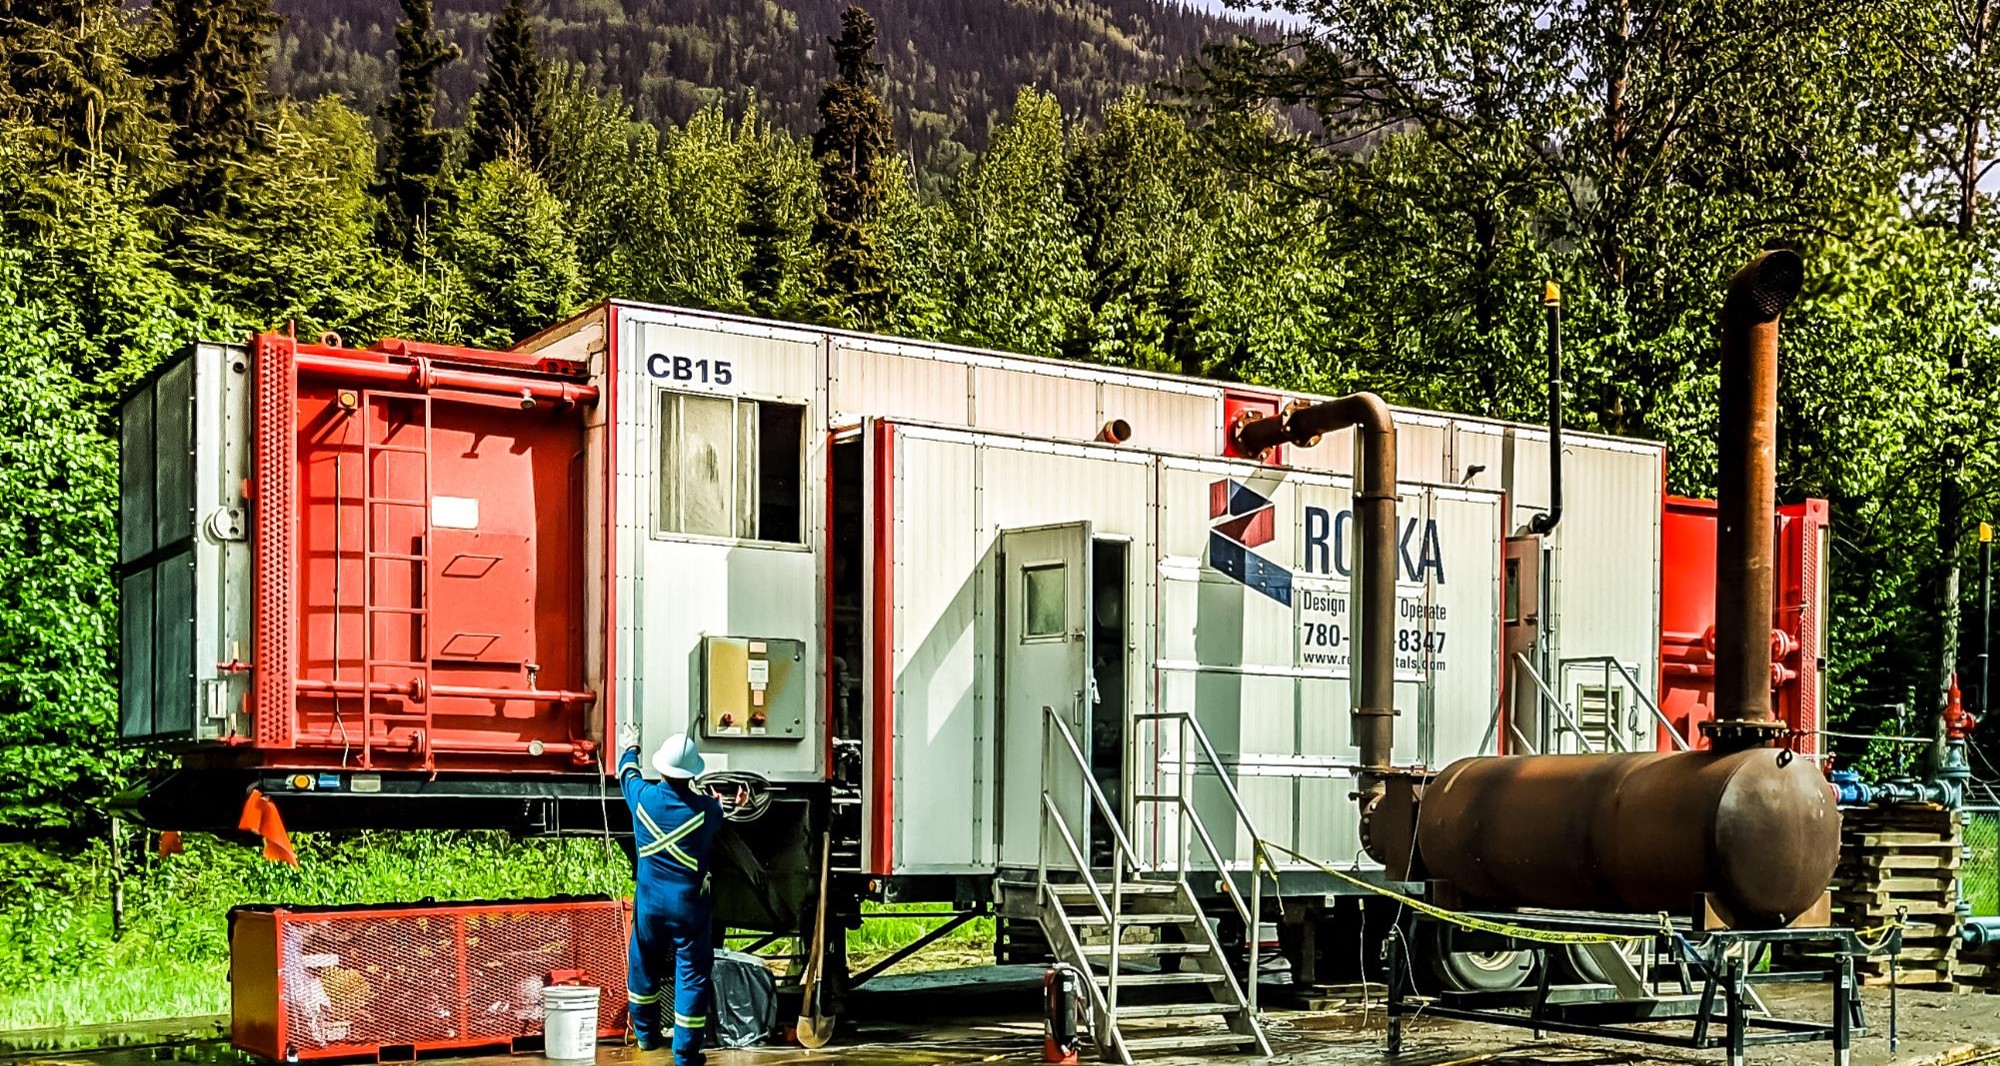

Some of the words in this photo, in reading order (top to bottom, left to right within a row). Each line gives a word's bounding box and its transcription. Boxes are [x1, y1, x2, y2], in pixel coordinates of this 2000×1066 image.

[647, 353, 733, 385] CB15
[1305, 506, 1446, 585] ROKA
[1303, 591, 1346, 617] Design
[1400, 598, 1447, 622] Operate
[1477, 921, 1504, 933] CAUTION
[1509, 928, 1536, 939] CAUTION
[1540, 932, 1565, 942] CAUTION
